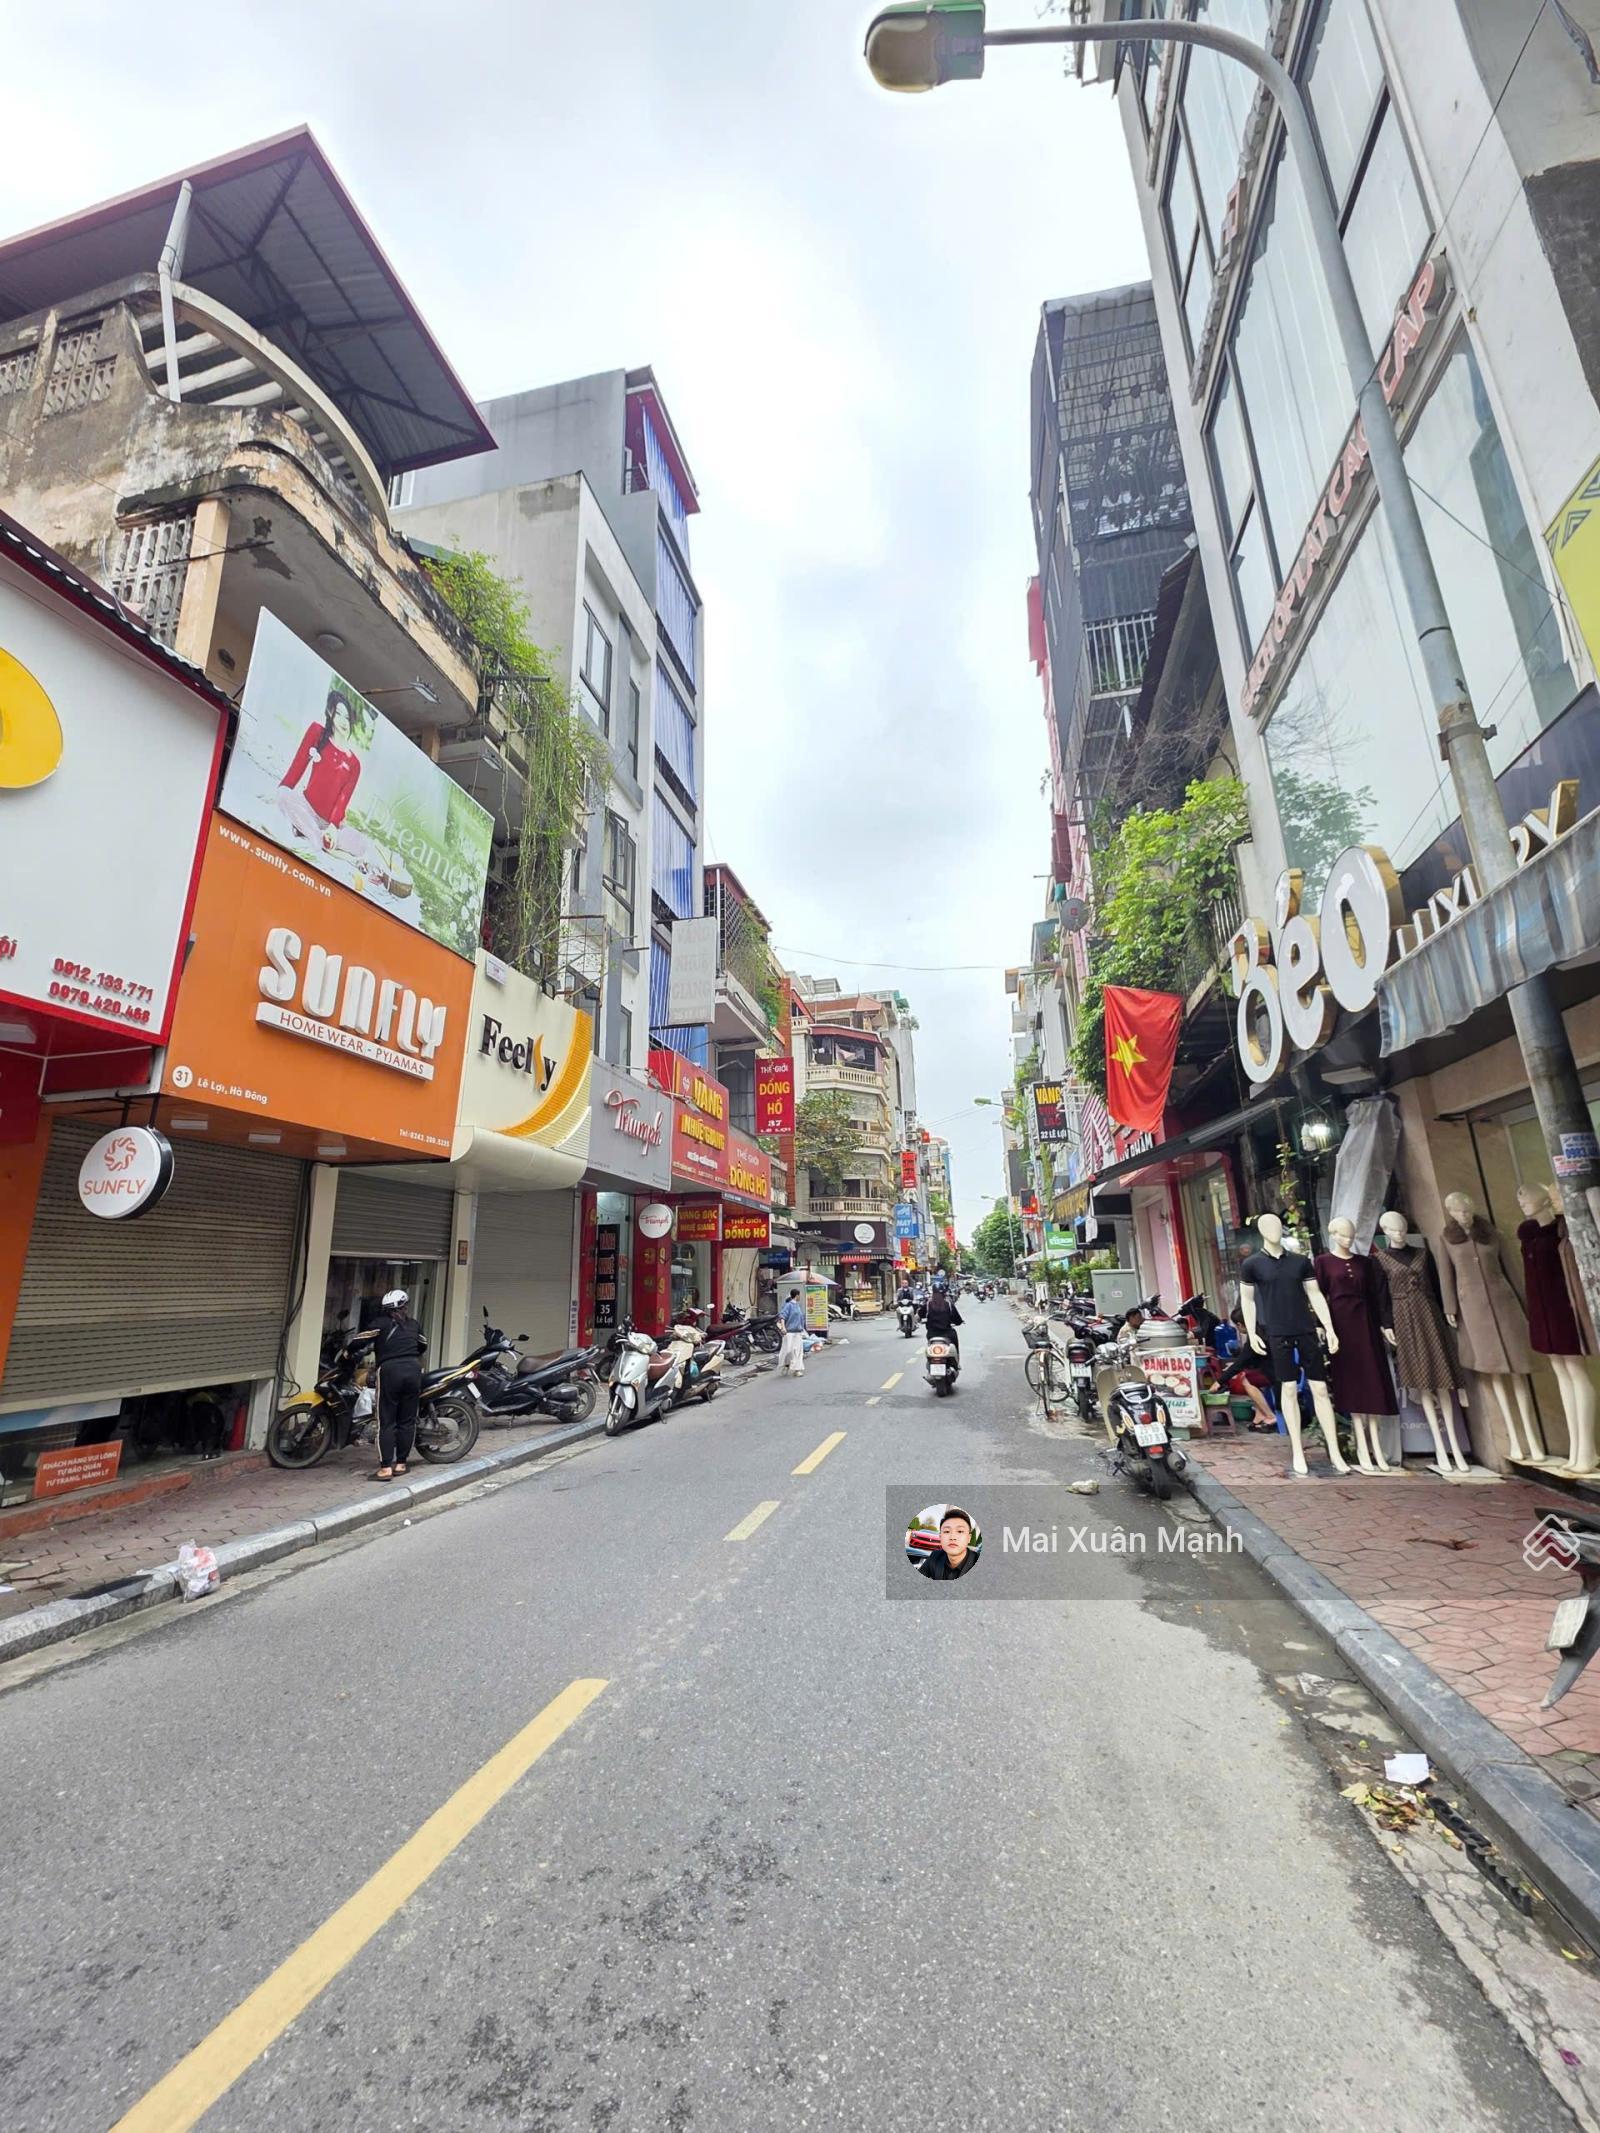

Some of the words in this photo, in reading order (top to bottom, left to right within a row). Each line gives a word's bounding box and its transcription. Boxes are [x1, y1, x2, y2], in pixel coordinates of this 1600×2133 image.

[218, 824, 332, 898] www.sunfly.com.vn
[375, 1047, 425, 1075] PYJAMAS
[175, 1070, 190, 1083] 31
[197, 1077, 209, 1088] Lê
[229, 1085, 242, 1097] Hà
[244, 1089, 268, 1105] Đông
[604, 1089, 664, 1156] Triumph
[83, 1179, 146, 1195] SUNFLY
[600, 1304, 611, 1314] 35
